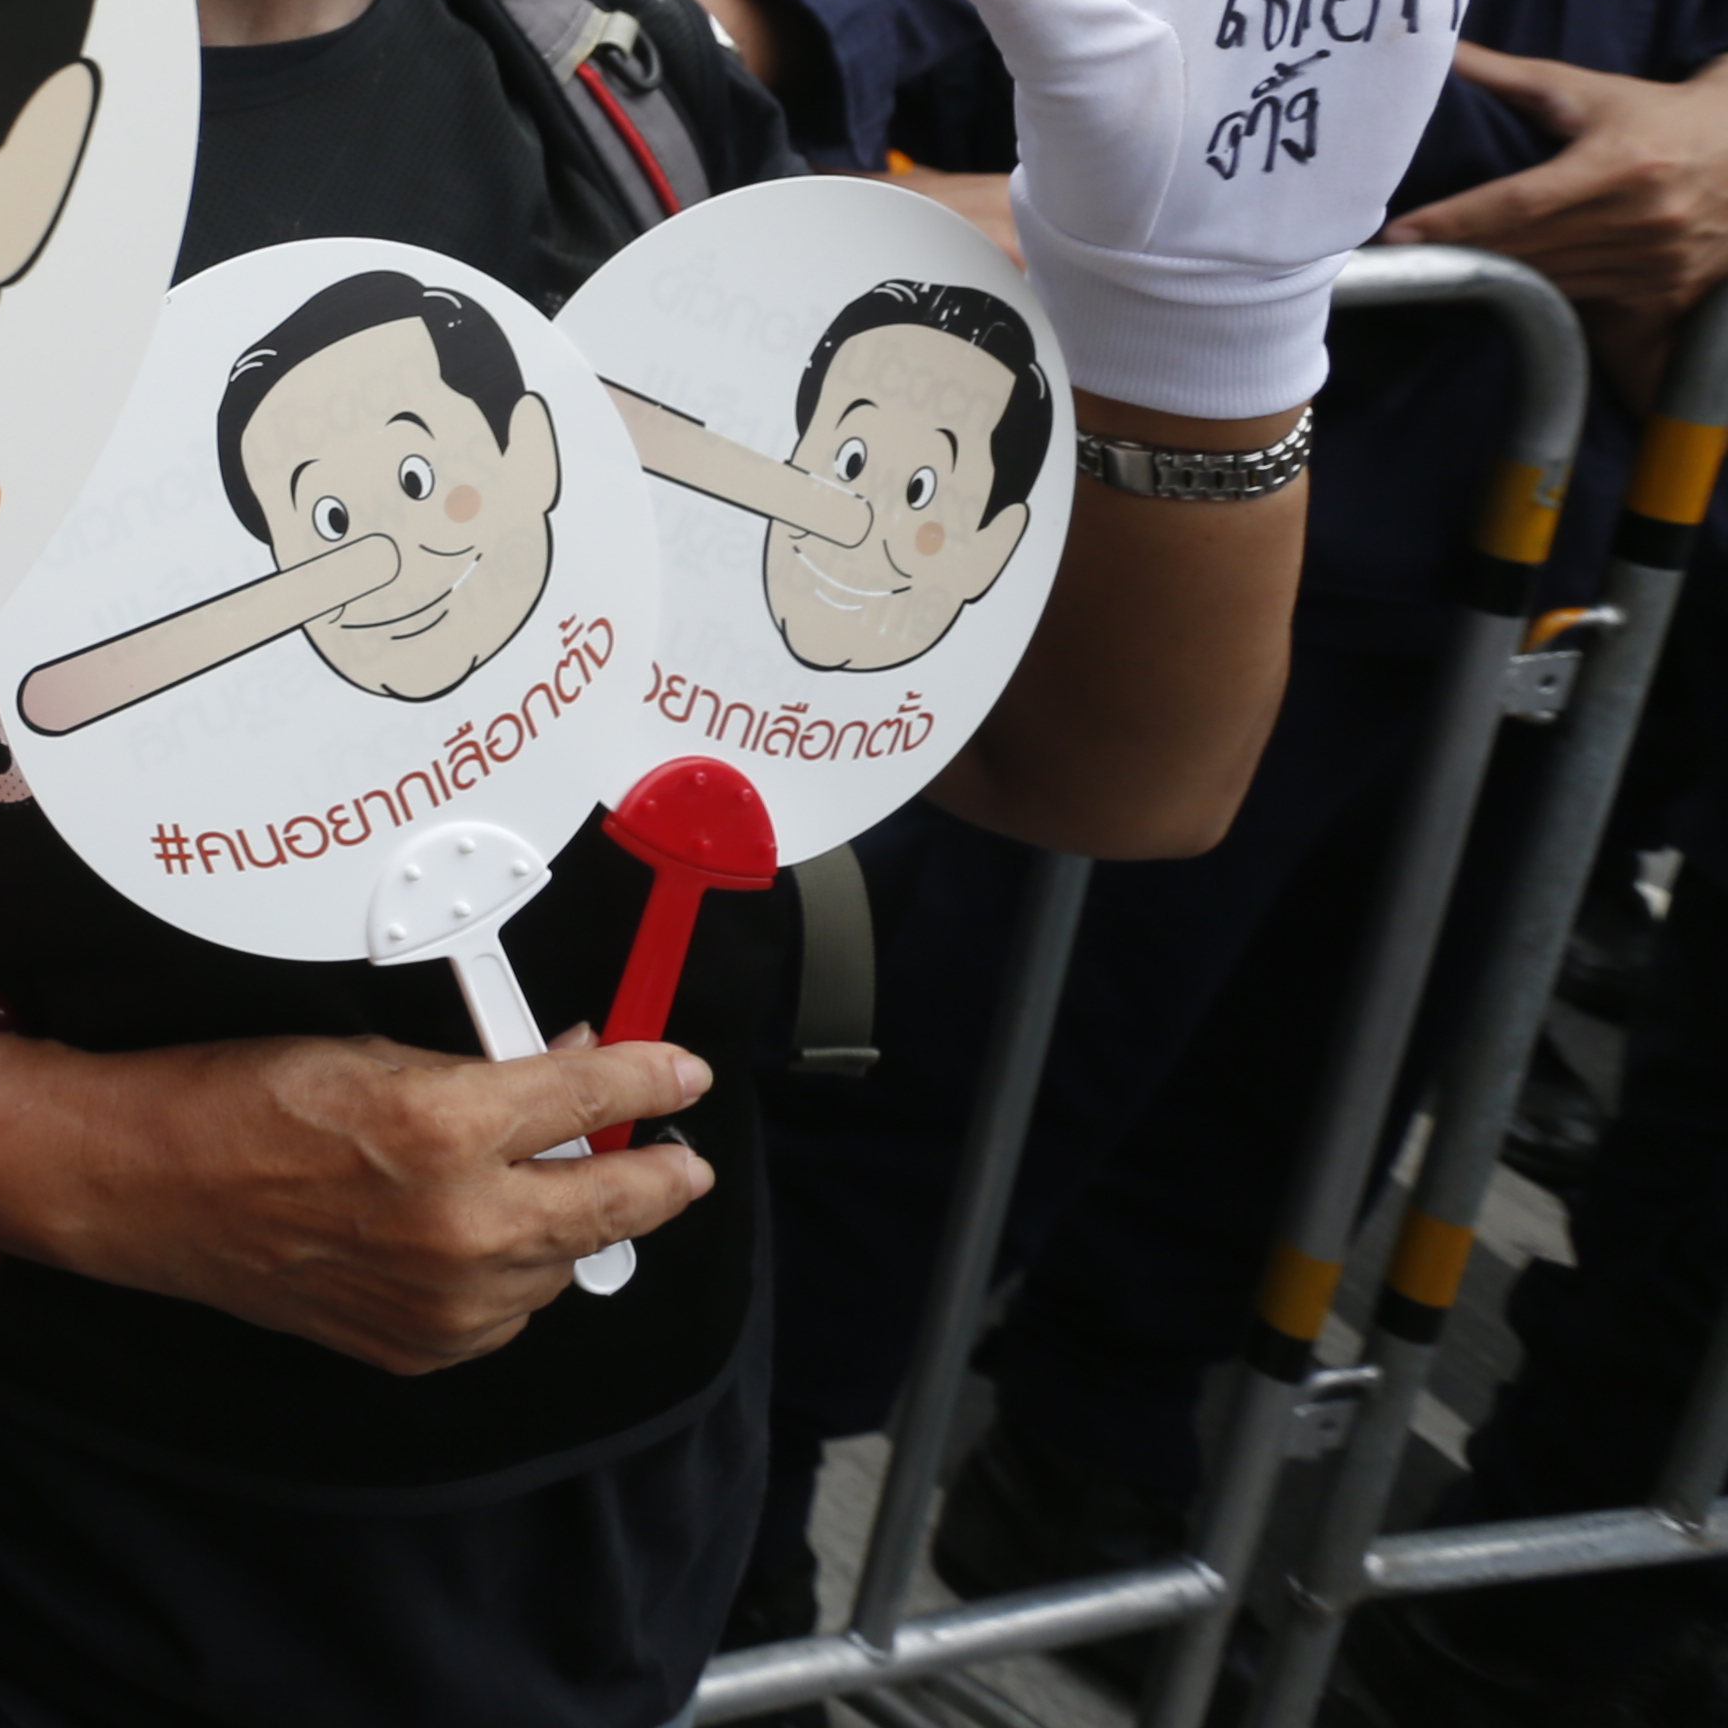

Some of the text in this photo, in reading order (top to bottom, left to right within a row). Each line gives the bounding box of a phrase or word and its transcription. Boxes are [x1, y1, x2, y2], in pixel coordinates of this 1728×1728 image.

[150, 614, 617, 876] #คนอยากเลือกตั้ง
